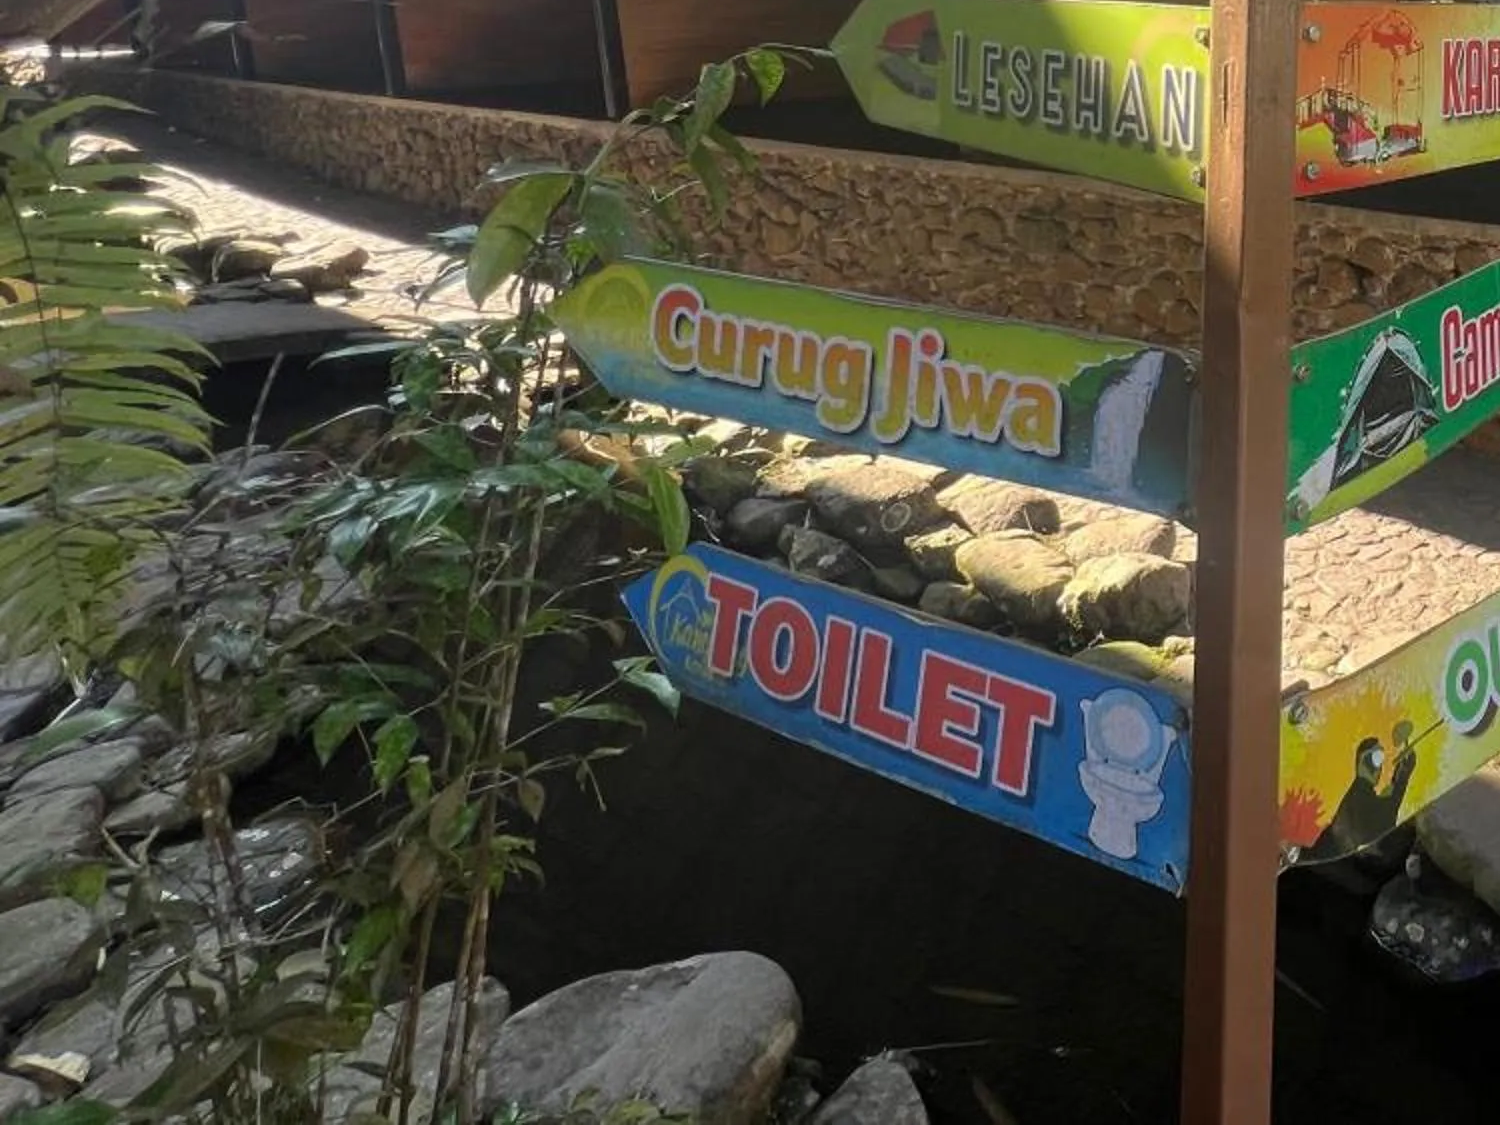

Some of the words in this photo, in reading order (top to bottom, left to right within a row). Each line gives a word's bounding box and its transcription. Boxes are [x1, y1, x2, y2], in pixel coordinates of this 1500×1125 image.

[952, 29, 1197, 153] LESEHAN
[650, 282, 875, 435] Curug
[870, 327, 1064, 458] Jiwa
[704, 572, 1057, 798] TOILET
